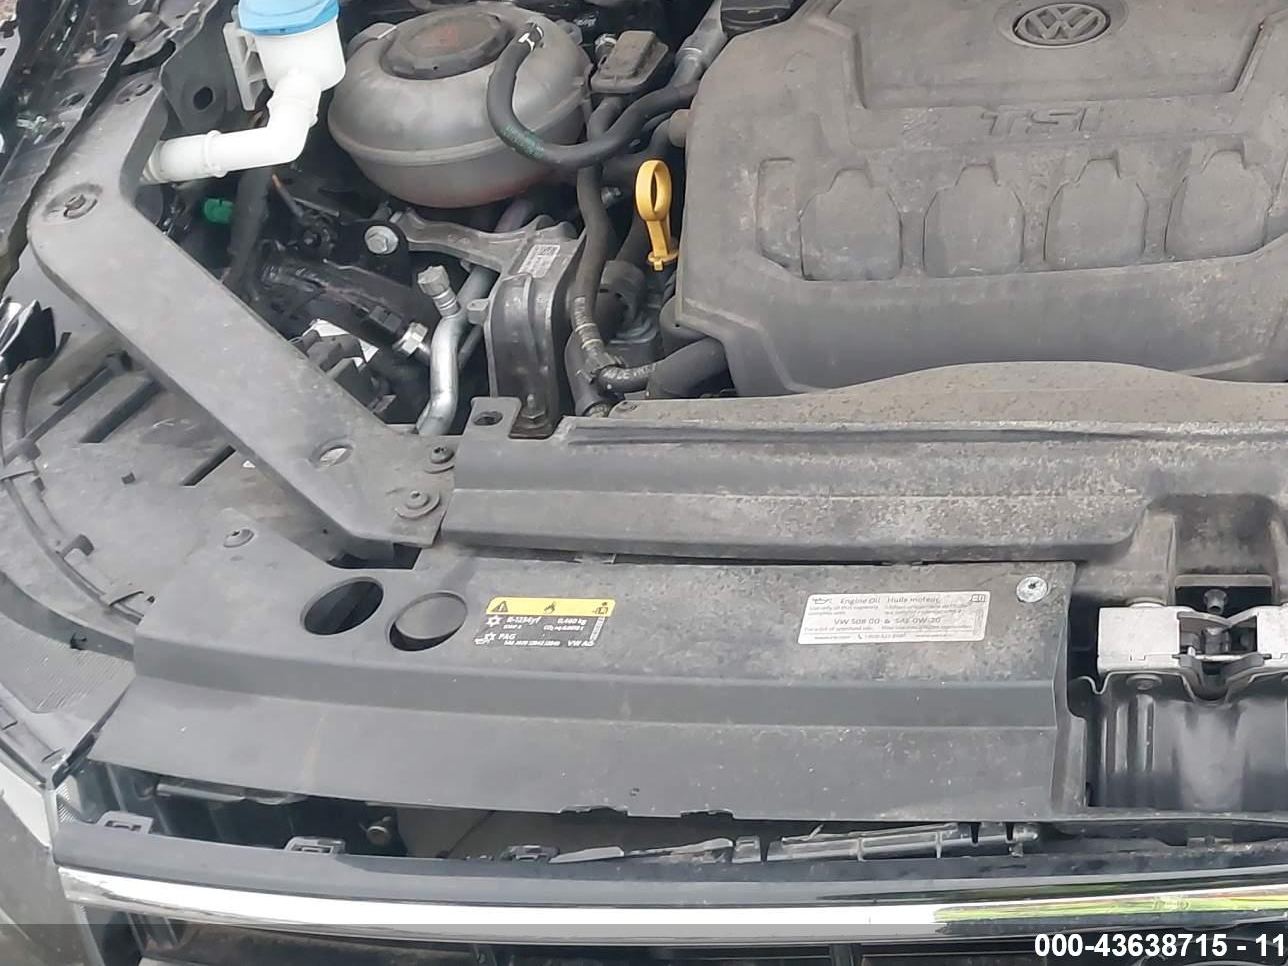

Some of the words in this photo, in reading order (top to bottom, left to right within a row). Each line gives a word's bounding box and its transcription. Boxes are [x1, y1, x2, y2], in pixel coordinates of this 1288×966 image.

[980, 106, 1094, 135] TSI
[840, 596, 867, 605] Engine
[868, 595, 880, 604] Oil
